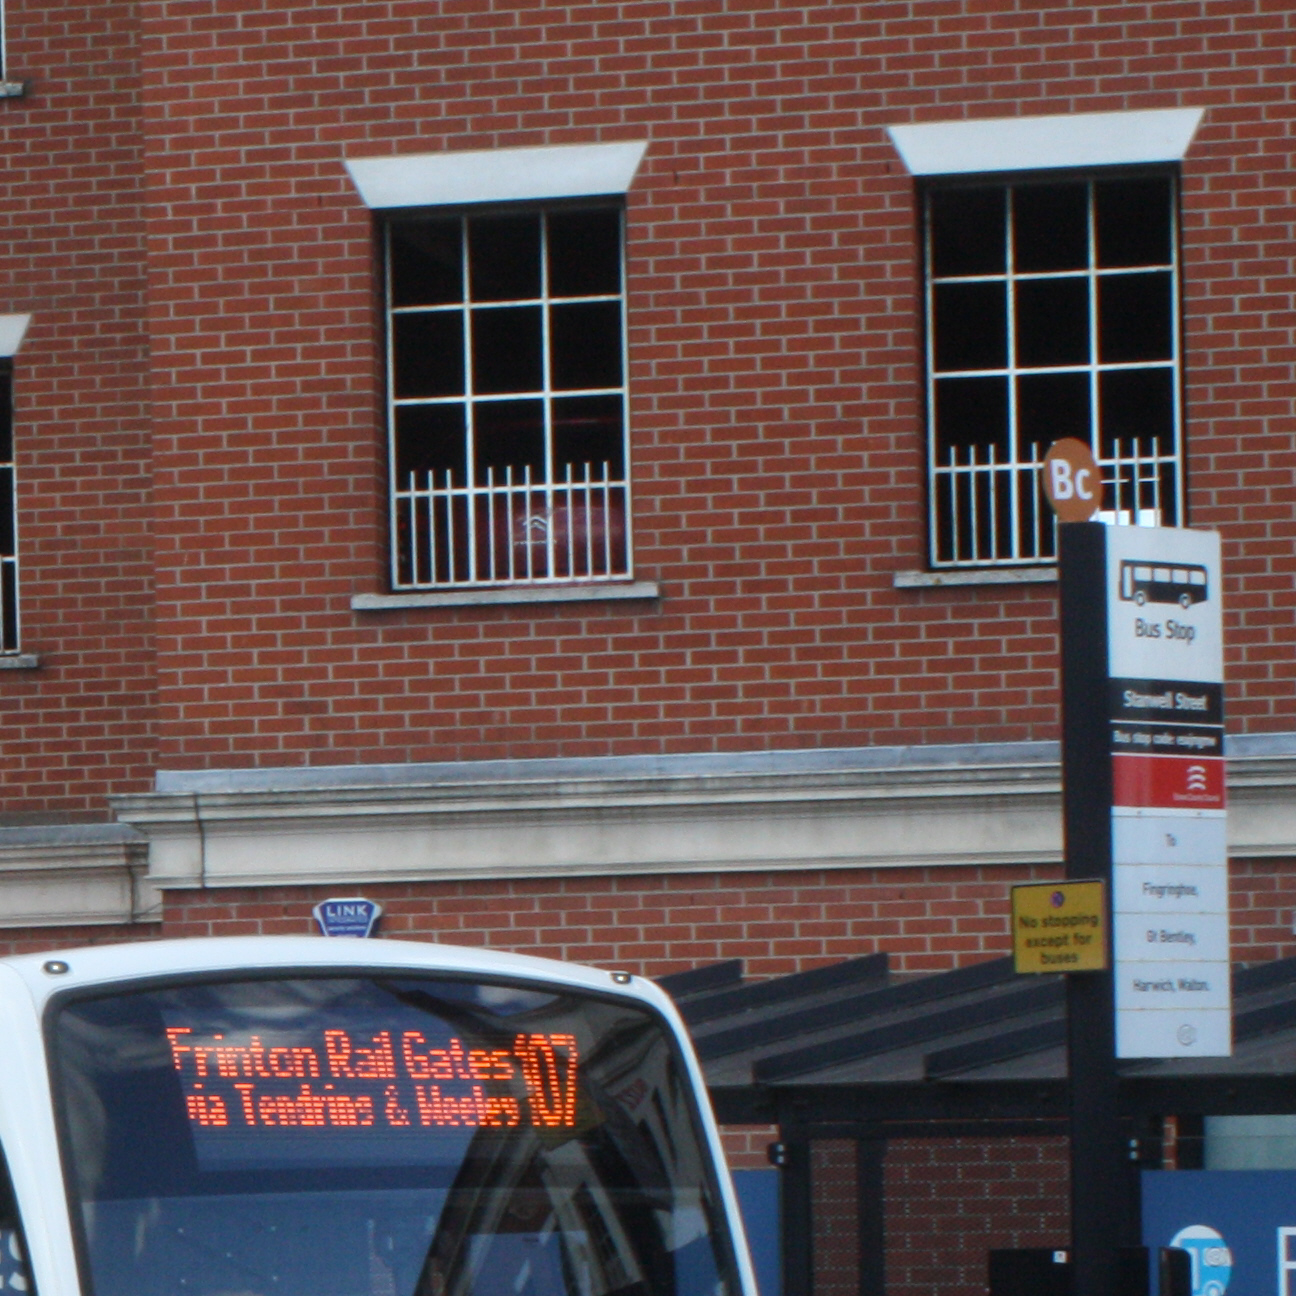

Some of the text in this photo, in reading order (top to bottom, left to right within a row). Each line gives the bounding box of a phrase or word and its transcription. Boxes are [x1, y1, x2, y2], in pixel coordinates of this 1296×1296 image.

[1050, 458, 1094, 500] Bc
[1135, 618, 1195, 645] Bus Stop
[326, 904, 368, 916] LINK
[1019, 914, 1098, 930] No stopping
[166, 1027, 515, 1080] Frinton Rail Gates
[382, 1084, 411, 1127] &
